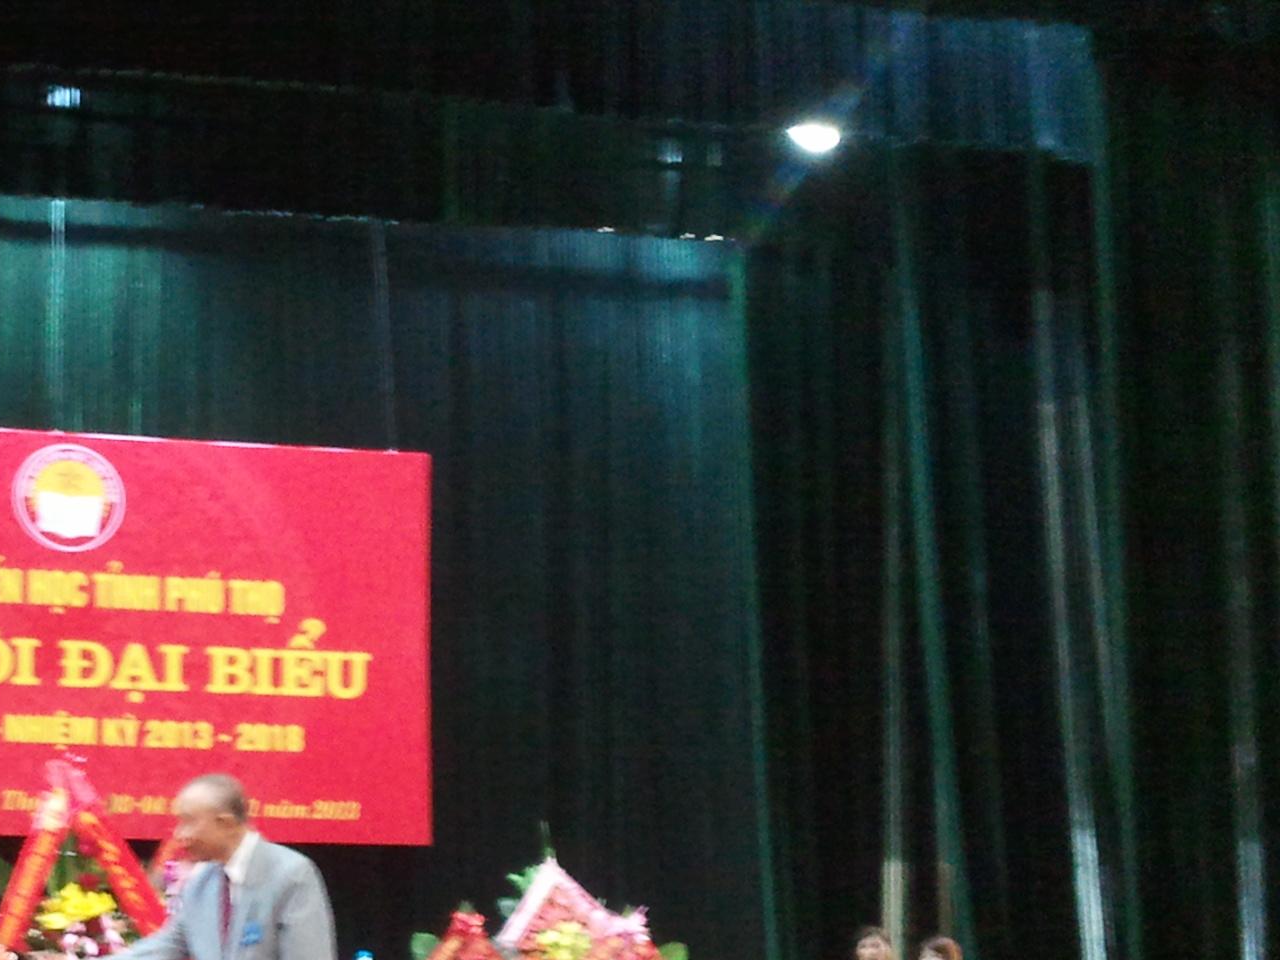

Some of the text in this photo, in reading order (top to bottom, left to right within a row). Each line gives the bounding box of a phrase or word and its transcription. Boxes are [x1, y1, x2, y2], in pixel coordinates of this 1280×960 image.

[57, 639, 190, 703] ĐẠI
[204, 618, 373, 700] BIỂU
[143, 719, 214, 751] 2013
